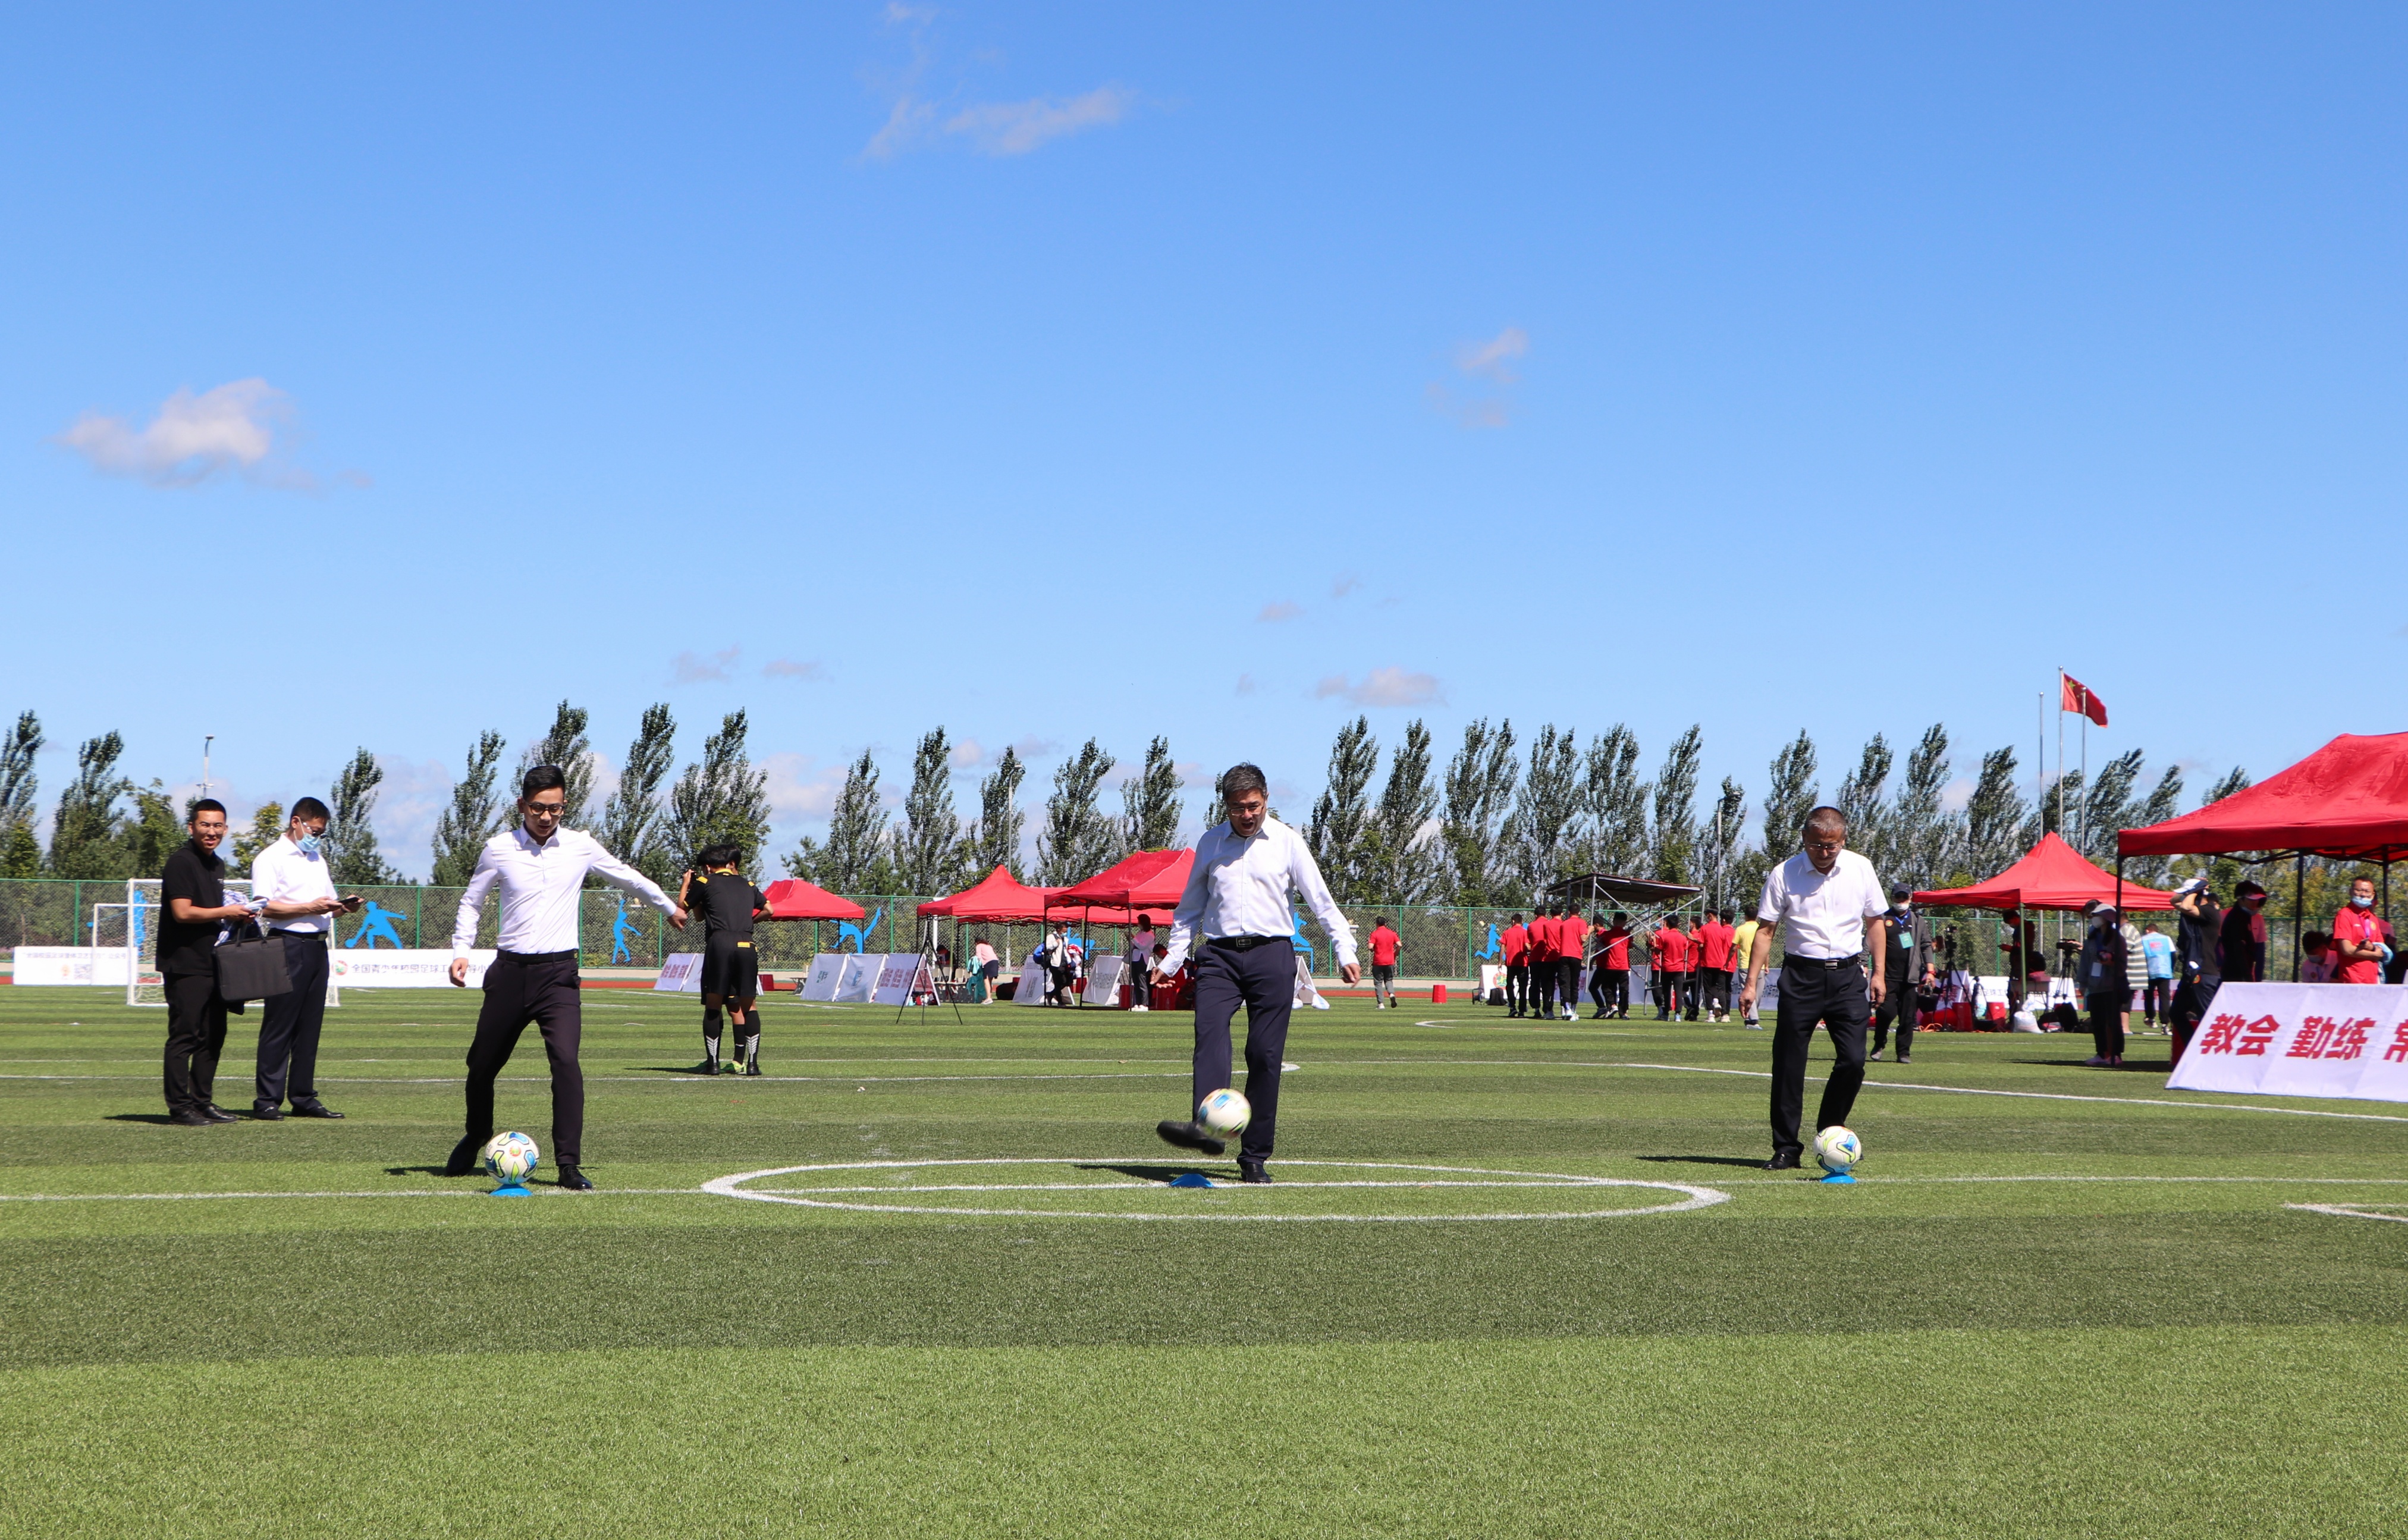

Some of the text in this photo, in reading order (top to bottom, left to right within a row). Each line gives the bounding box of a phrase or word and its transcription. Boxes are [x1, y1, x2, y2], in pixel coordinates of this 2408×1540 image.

[351, 964, 488, 973] 全国青少年校园足球工导小
[2200, 1014, 2281, 1056] 教会
[2285, 1016, 2376, 1060] 勤练
